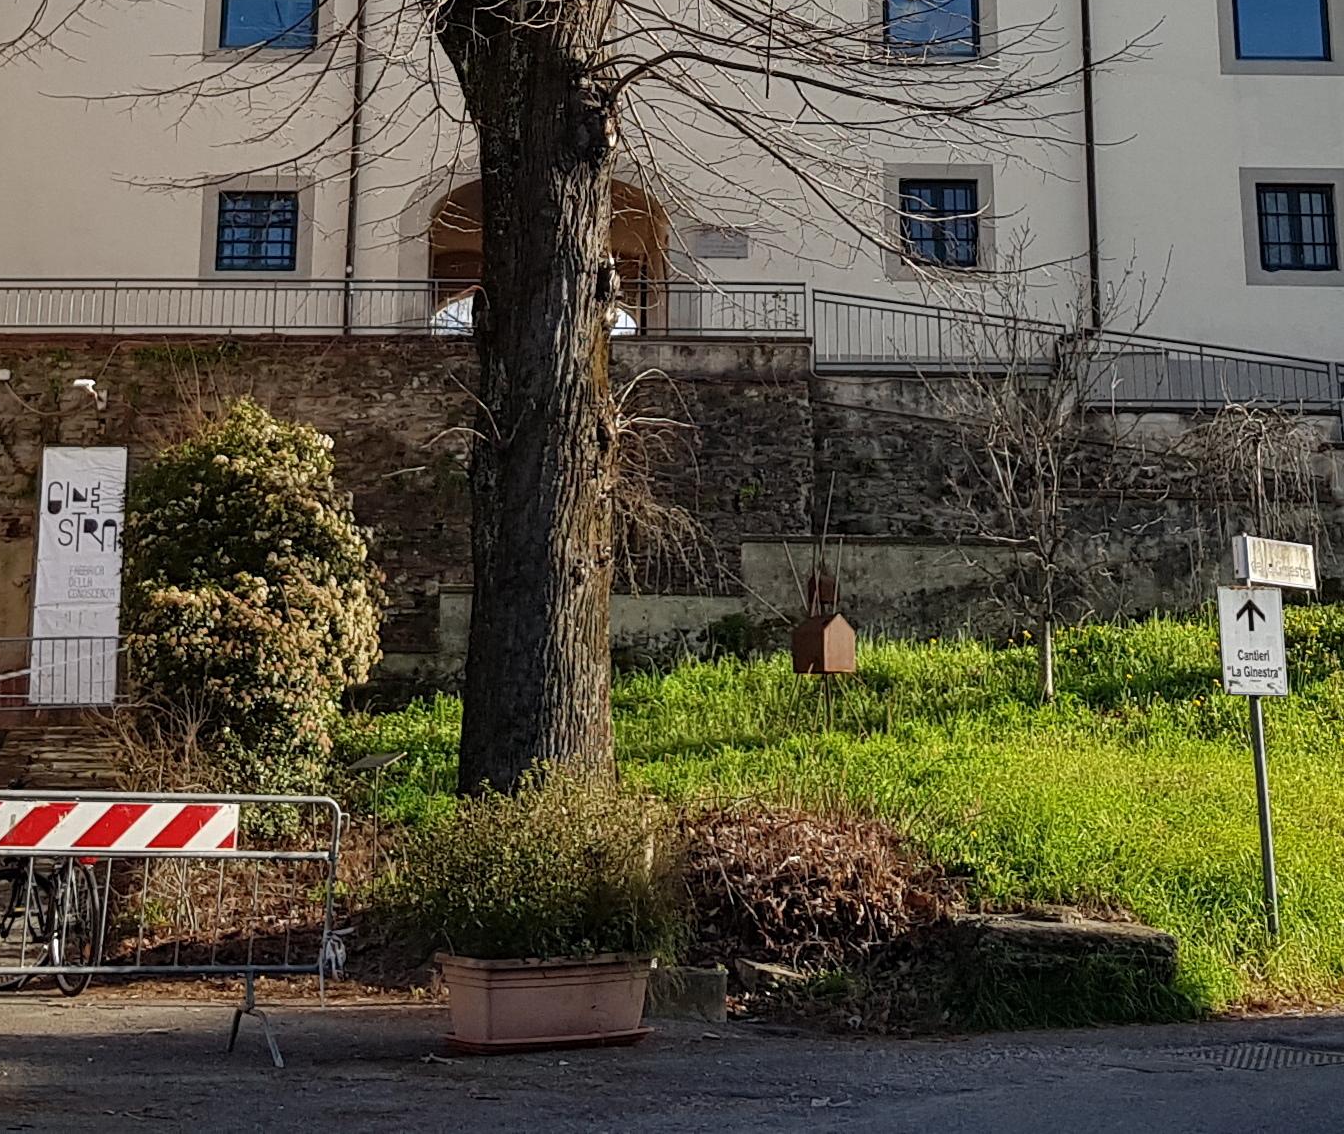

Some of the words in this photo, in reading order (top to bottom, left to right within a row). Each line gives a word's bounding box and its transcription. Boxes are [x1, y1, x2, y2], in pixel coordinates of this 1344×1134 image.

[69, 565, 105, 575] FABBRICA
[68, 577, 93, 587] DELLA
[1237, 649, 1270, 661] Cantieri
